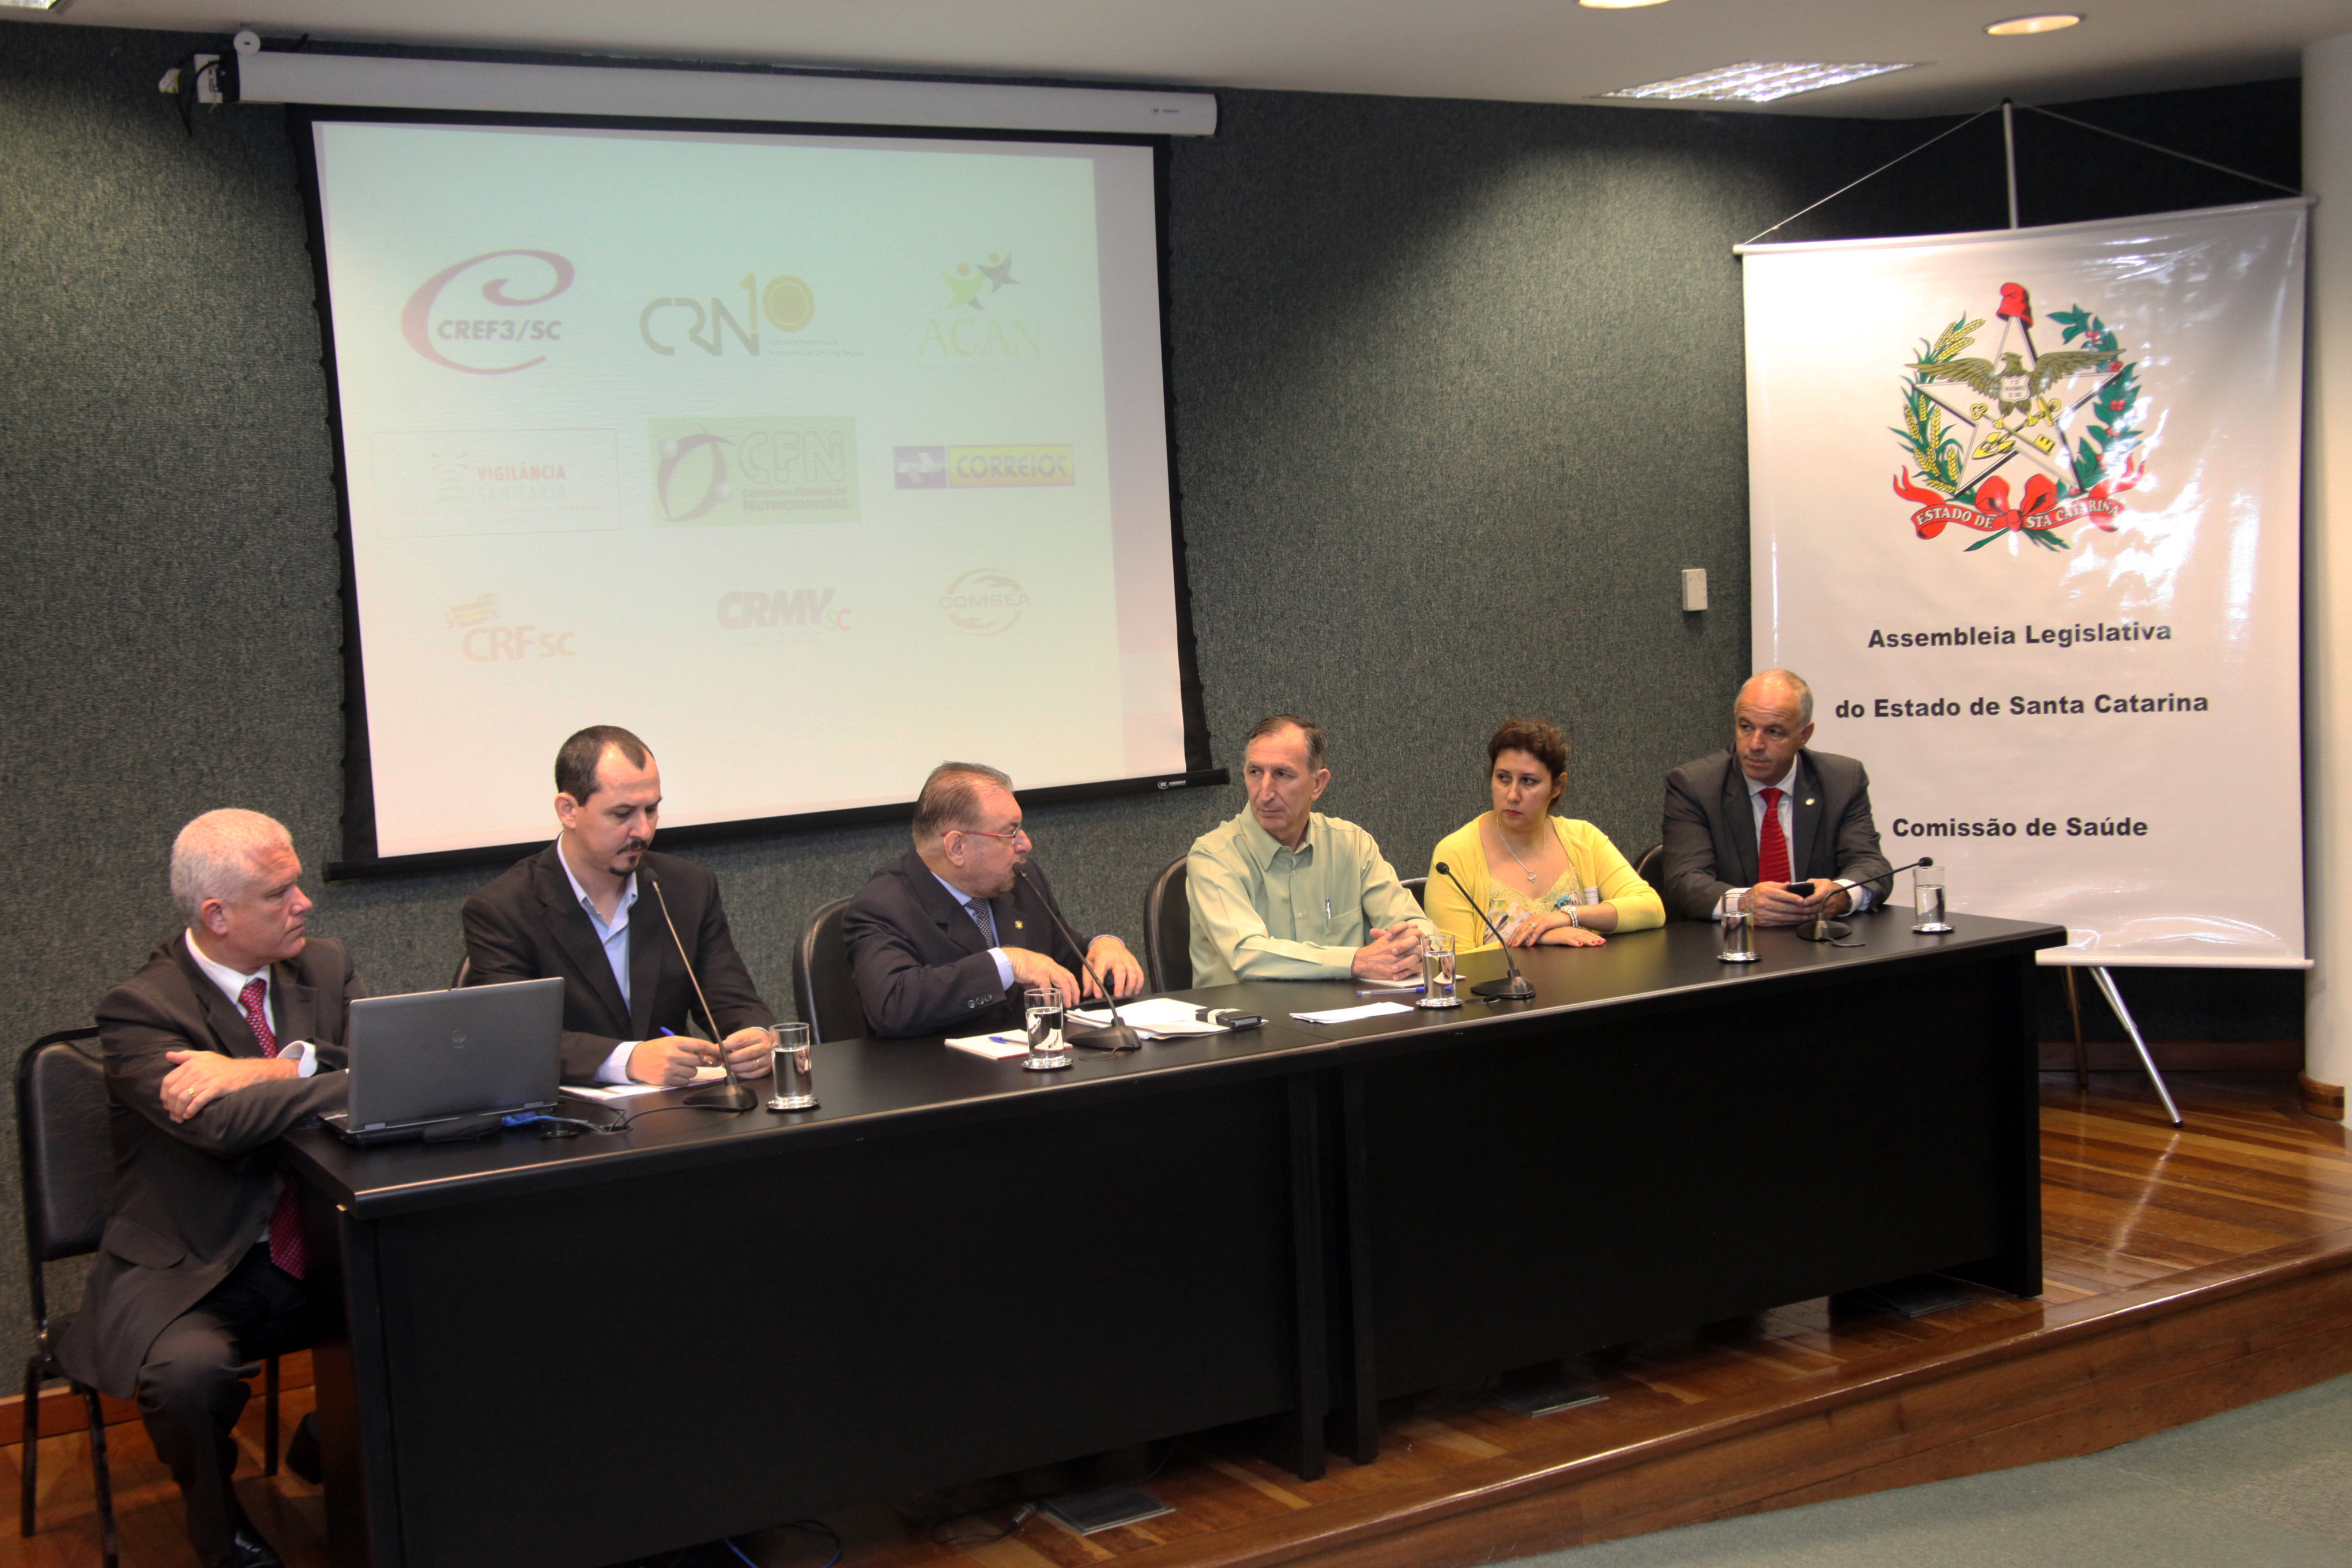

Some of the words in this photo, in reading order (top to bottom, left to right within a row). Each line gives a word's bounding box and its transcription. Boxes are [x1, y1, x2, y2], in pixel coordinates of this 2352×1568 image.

[438, 319, 562, 341] CREF3/SC
[917, 318, 1042, 356] ACAN
[738, 431, 845, 484] CFN
[956, 454, 1066, 478] CORREIOS
[1916, 508, 1972, 526] ESTADO
[1974, 515, 1995, 529] DE
[2056, 499, 2119, 522] CATARINA
[939, 593, 1031, 609] COMSEA
[1868, 626, 2015, 648] Assembleia
[2026, 622, 2171, 648] Legislativa
[1835, 699, 1865, 718] do
[1874, 698, 1961, 718] Estado
[1969, 697, 2000, 716] de
[2010, 695, 2085, 715] Santa
[2094, 693, 2208, 714] Catarina
[1892, 817, 2017, 837] Comissão
[2026, 817, 2057, 836] de
[2066, 816, 2148, 836] Saúde
